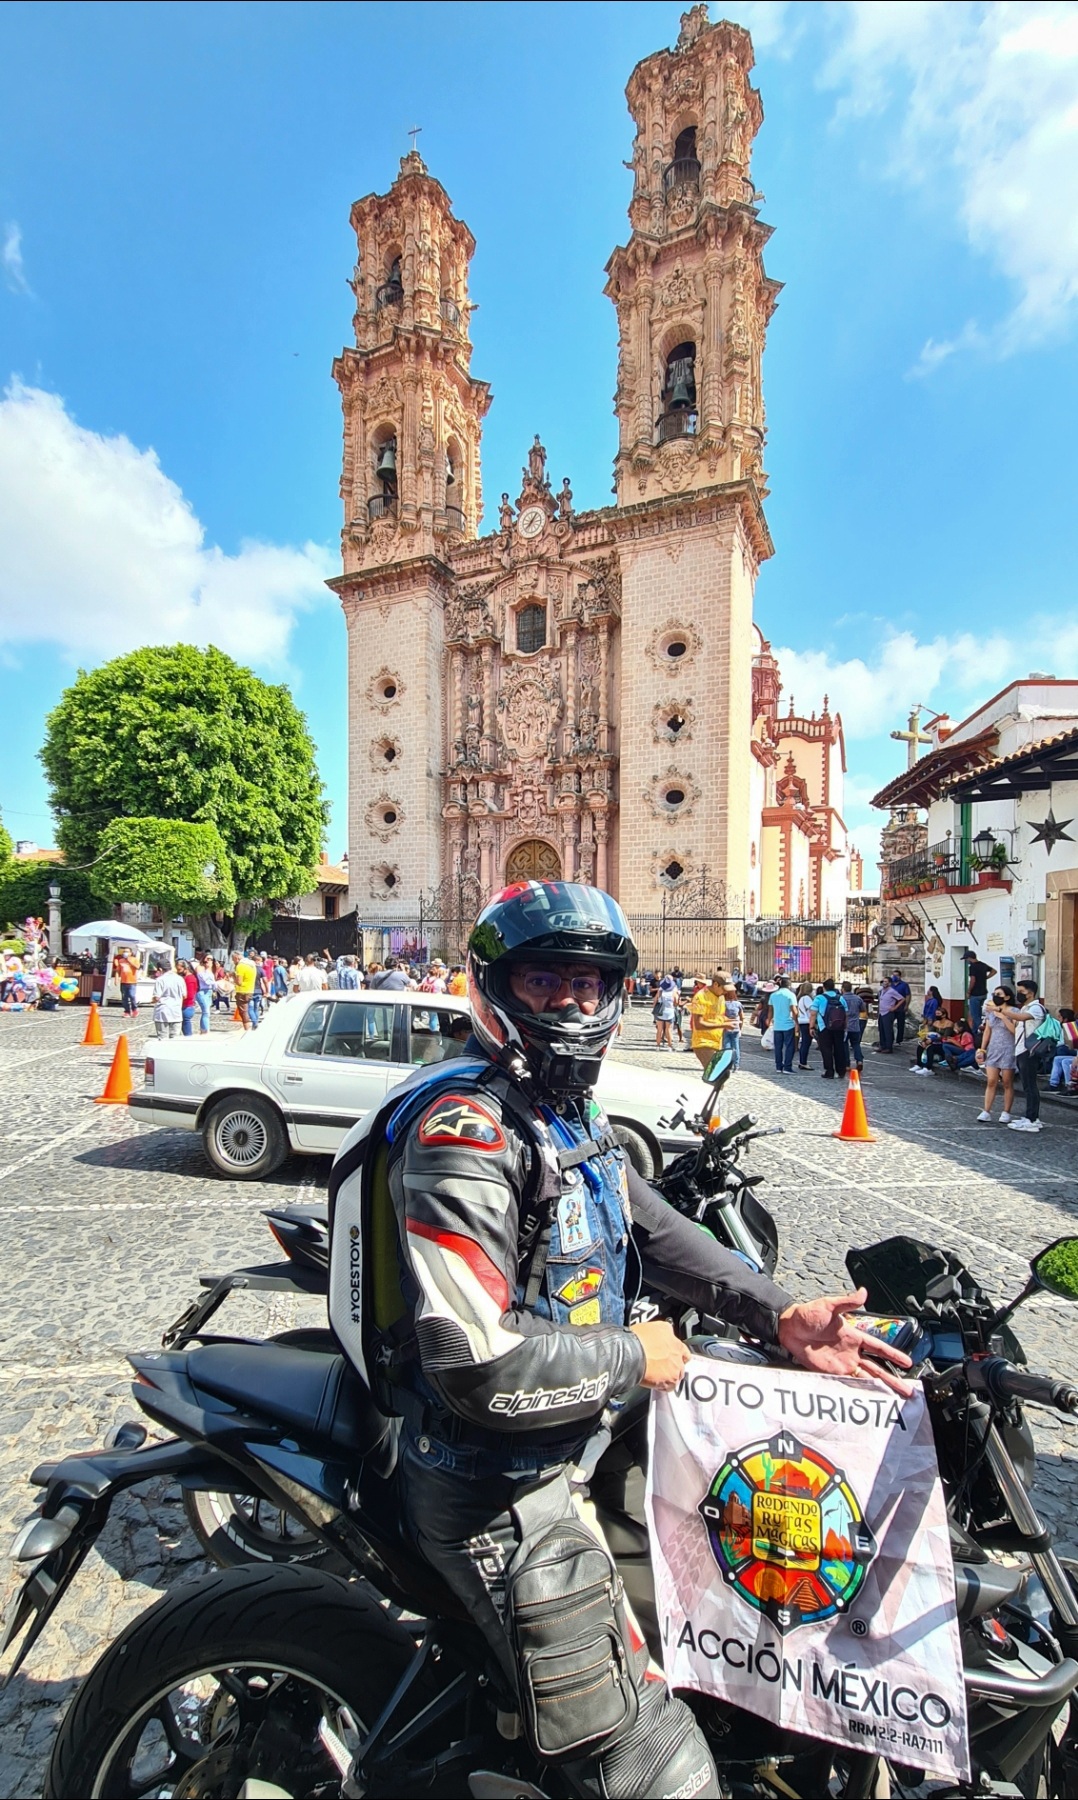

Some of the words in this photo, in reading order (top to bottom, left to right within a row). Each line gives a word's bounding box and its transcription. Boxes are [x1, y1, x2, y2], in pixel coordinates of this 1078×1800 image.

[350, 1239, 361, 1325] #YOESTOY
[576, 1269, 587, 1280] N
[673, 1372, 765, 1410] MOTO
[774, 1388, 908, 1432] TURISTA
[777, 1438, 795, 1455] N
[854, 1535, 871, 1552] E
[777, 1608, 791, 1626] S
[677, 1620, 803, 1692] ACCIÓN
[812, 1661, 951, 1728] MÉXICO
